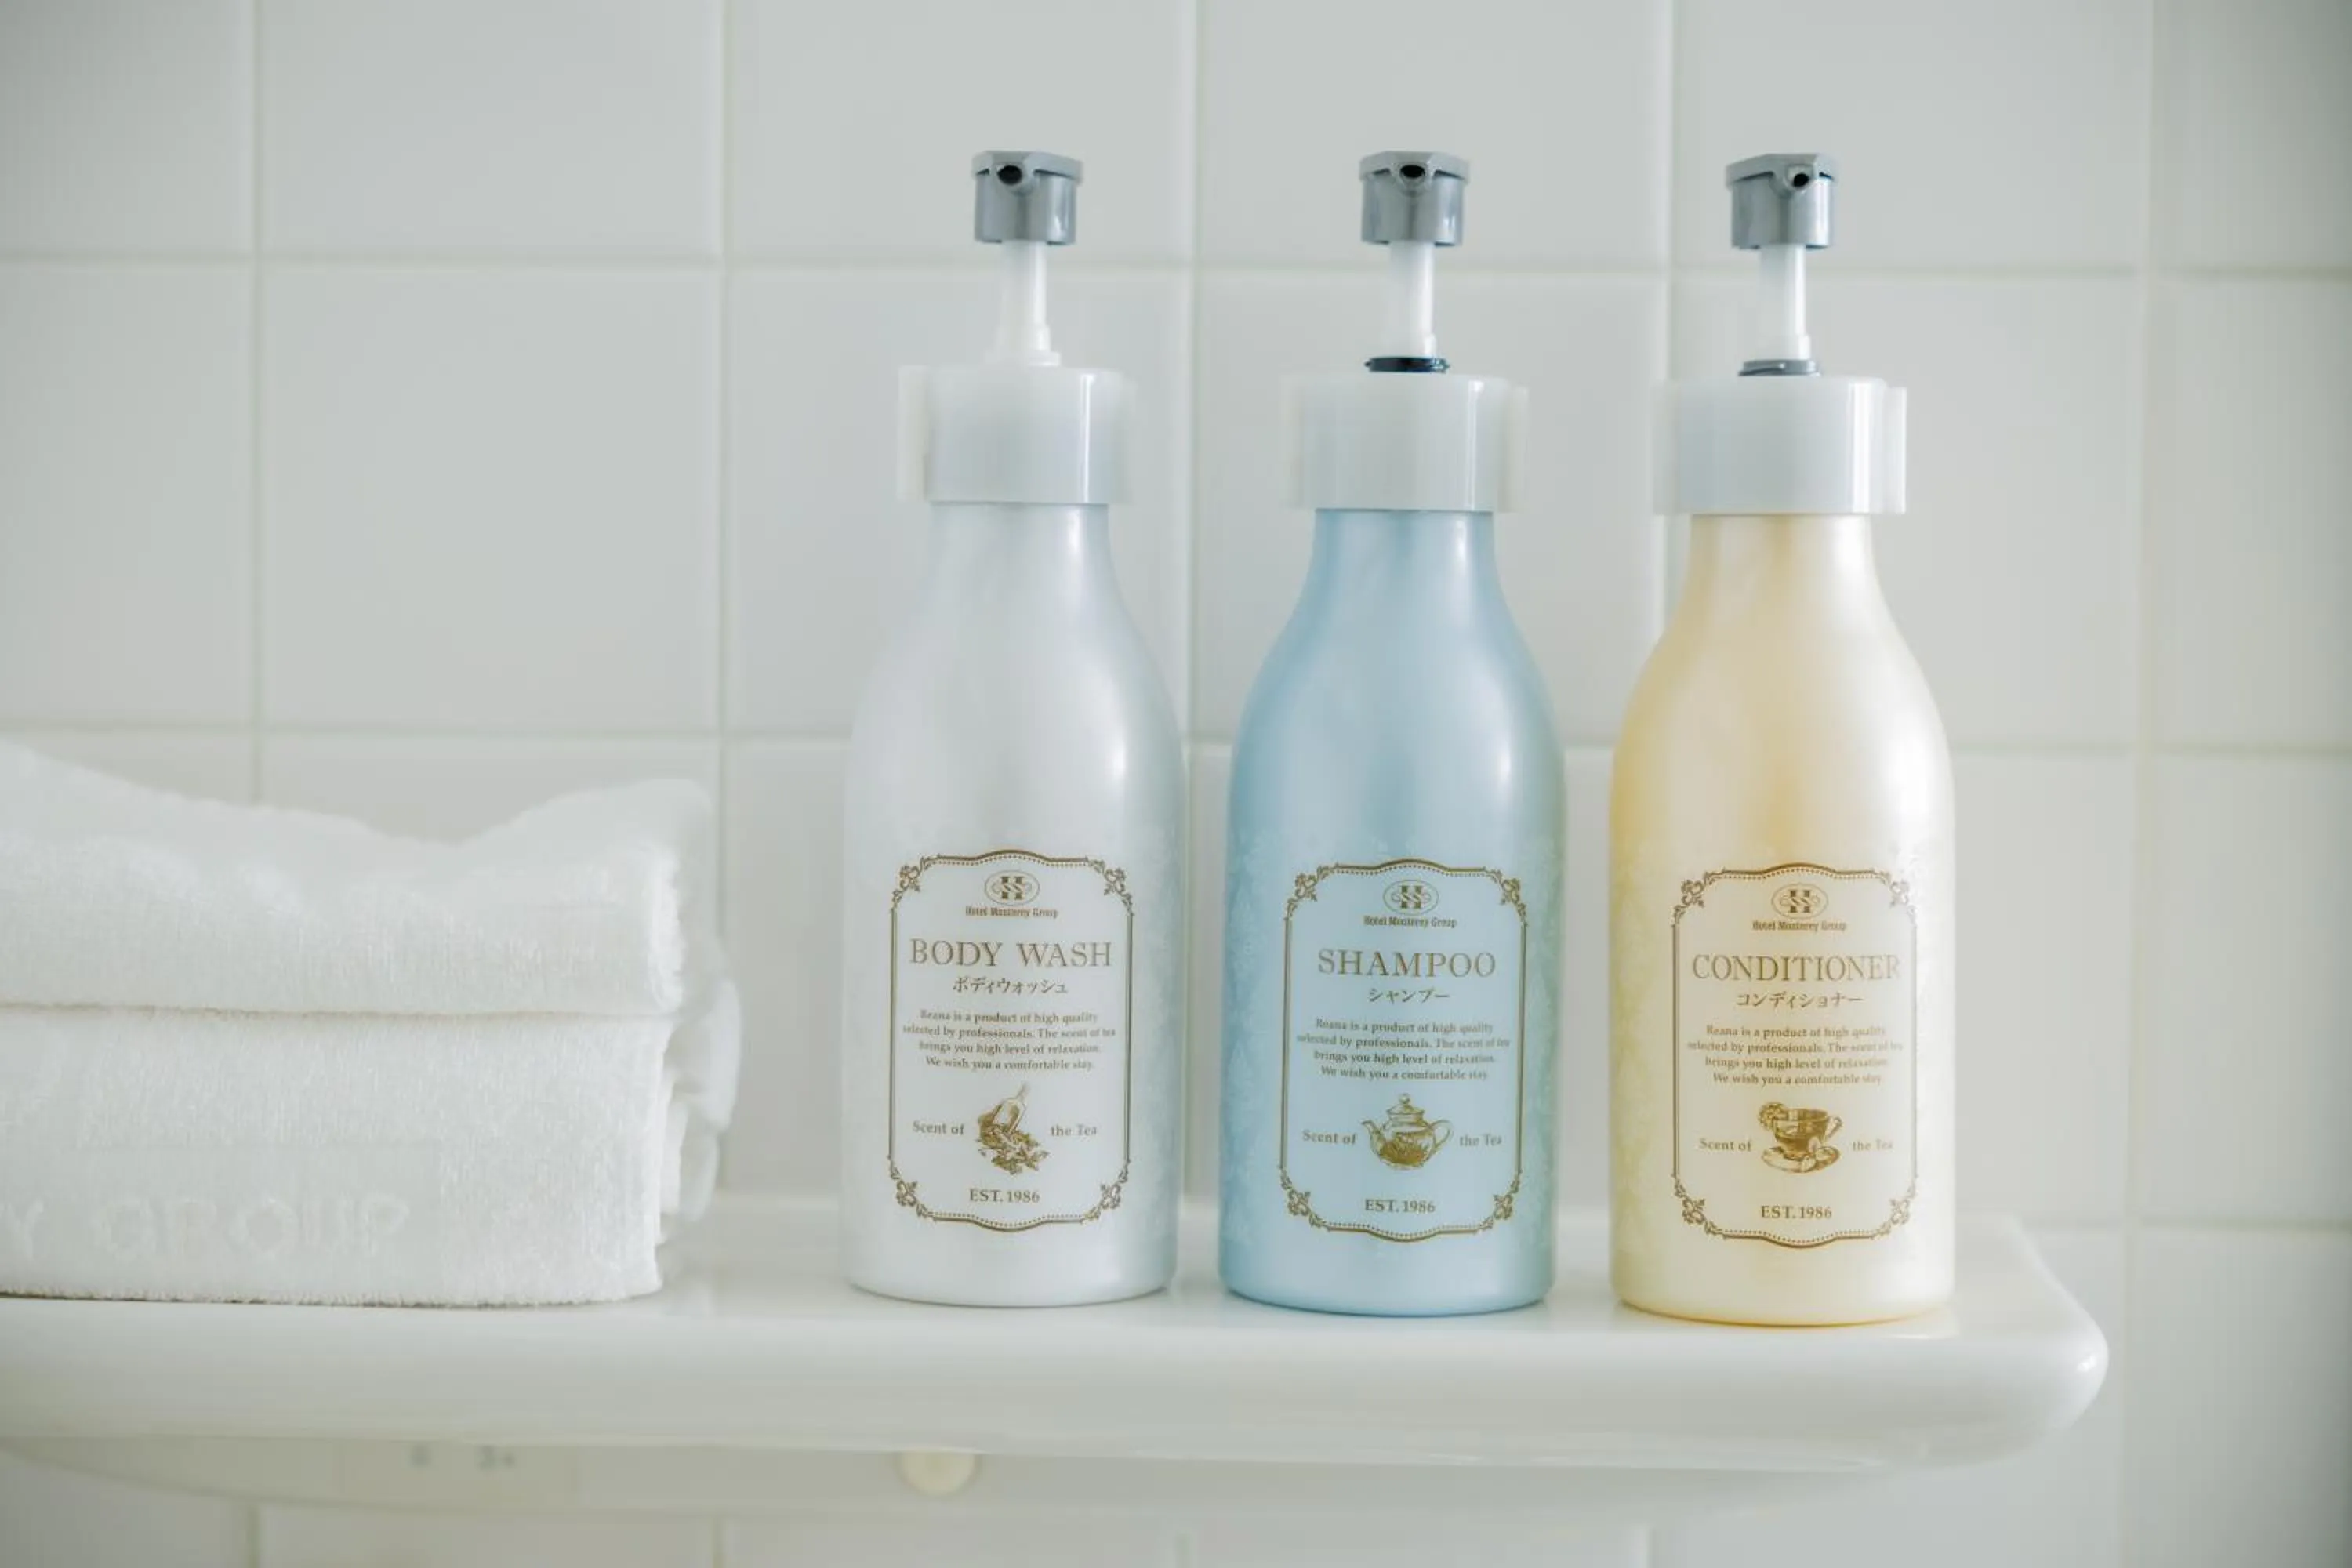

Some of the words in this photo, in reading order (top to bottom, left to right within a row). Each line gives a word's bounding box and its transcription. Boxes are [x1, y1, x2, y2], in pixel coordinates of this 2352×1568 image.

[965, 906, 988, 916] Hotel
[990, 906, 1030, 918] Monterey
[1033, 908, 1058, 919] Group
[1363, 916, 1387, 925] Hotel
[1388, 916, 1428, 927] Monterey
[1431, 918, 1457, 928] Group
[1752, 921, 1776, 931] Hotel
[1777, 921, 1819, 932] Monterey
[909, 938, 1003, 967] BODY
[1016, 942, 1112, 967] WASH
[1318, 948, 1496, 978] SHAMPOO
[1693, 953, 1901, 981] CONDITIONER
[953, 976, 1068, 994] ボディウォッシュ
[1368, 987, 1450, 1004] シャンプー
[1737, 991, 1864, 1008] コンディショナー
[974, 1012, 1017, 1025] product
[1020, 1013, 1032, 1022] of
[1034, 1012, 1059, 1025] high
[1062, 1013, 1097, 1025] quality
[902, 1025, 940, 1036] selected
[943, 1025, 955, 1039] by
[959, 1027, 1035, 1040] professionals.
[1037, 1028, 1058, 1039] The
[1061, 1029, 1087, 1038] scent
[1090, 1028, 1100, 1037] of
[1371, 1022, 1414, 1033] product
[1417, 1023, 1429, 1033] of
[1432, 1022, 1456, 1033] high
[1460, 1023, 1493, 1033] quality
[1741, 1026, 1751, 1035] is
[1763, 1028, 1806, 1040] product
[1809, 1028, 1822, 1036] of
[1824, 1028, 1849, 1039] high
[919, 1040, 951, 1054] brings
[954, 1044, 973, 1055] you
[976, 1042, 1001, 1056] high
[1004, 1045, 1030, 1054] level
[1033, 1044, 1044, 1054] of
[1339, 1035, 1353, 1048] by
[1356, 1038, 1432, 1049] professionals.
[1435, 1039, 1455, 1048] The
[1486, 1039, 1496, 1047] of
[1730, 1042, 1744, 1054] by
[1748, 1044, 1824, 1054] professionals.
[1828, 1043, 1849, 1052] The
[926, 1056, 942, 1066] We
[944, 1058, 969, 1068] wish
[971, 1060, 993, 1071] you
[1004, 1059, 1069, 1070] comfortable
[1314, 1050, 1348, 1062] brings
[1350, 1054, 1370, 1065] you
[1373, 1053, 1399, 1066] high
[1403, 1054, 1428, 1064] level
[1431, 1054, 1443, 1064] of
[1705, 1058, 1740, 1069] brings
[1742, 1060, 1762, 1070] you
[1766, 1058, 1791, 1071] high
[1795, 1059, 1820, 1069] level
[1824, 1059, 1835, 1068] of
[1321, 1065, 1337, 1076] We
[1340, 1068, 1366, 1078] wish
[1369, 1070, 1390, 1080] you
[1401, 1069, 1466, 1080] comfortable
[1713, 1073, 1728, 1083] We
[1733, 1074, 1759, 1084] wish
[1762, 1076, 1782, 1087] you
[1795, 1074, 1859, 1085] comfortable
[913, 1120, 946, 1134] Scent
[951, 1124, 964, 1136] of
[1051, 1125, 1072, 1136] the
[1077, 1124, 1097, 1136] Tea
[1302, 1130, 1338, 1143] Scent
[1342, 1134, 1356, 1145] of
[1460, 1134, 1480, 1146] the
[1483, 1134, 1502, 1145] Tea
[1699, 1138, 1734, 1152] Scent
[1738, 1141, 1751, 1152] of
[1852, 1140, 1871, 1151] the
[1875, 1140, 1893, 1149] Tea
[969, 1188, 1003, 1203] EST.
[1007, 1189, 1040, 1203] 1986
[1365, 1199, 1400, 1212] EST.
[1403, 1200, 1436, 1213] 1986
[1761, 1205, 1796, 1219] EST.
[1800, 1205, 1832, 1219] 1986
[90, 1192, 412, 1264] GROUP
